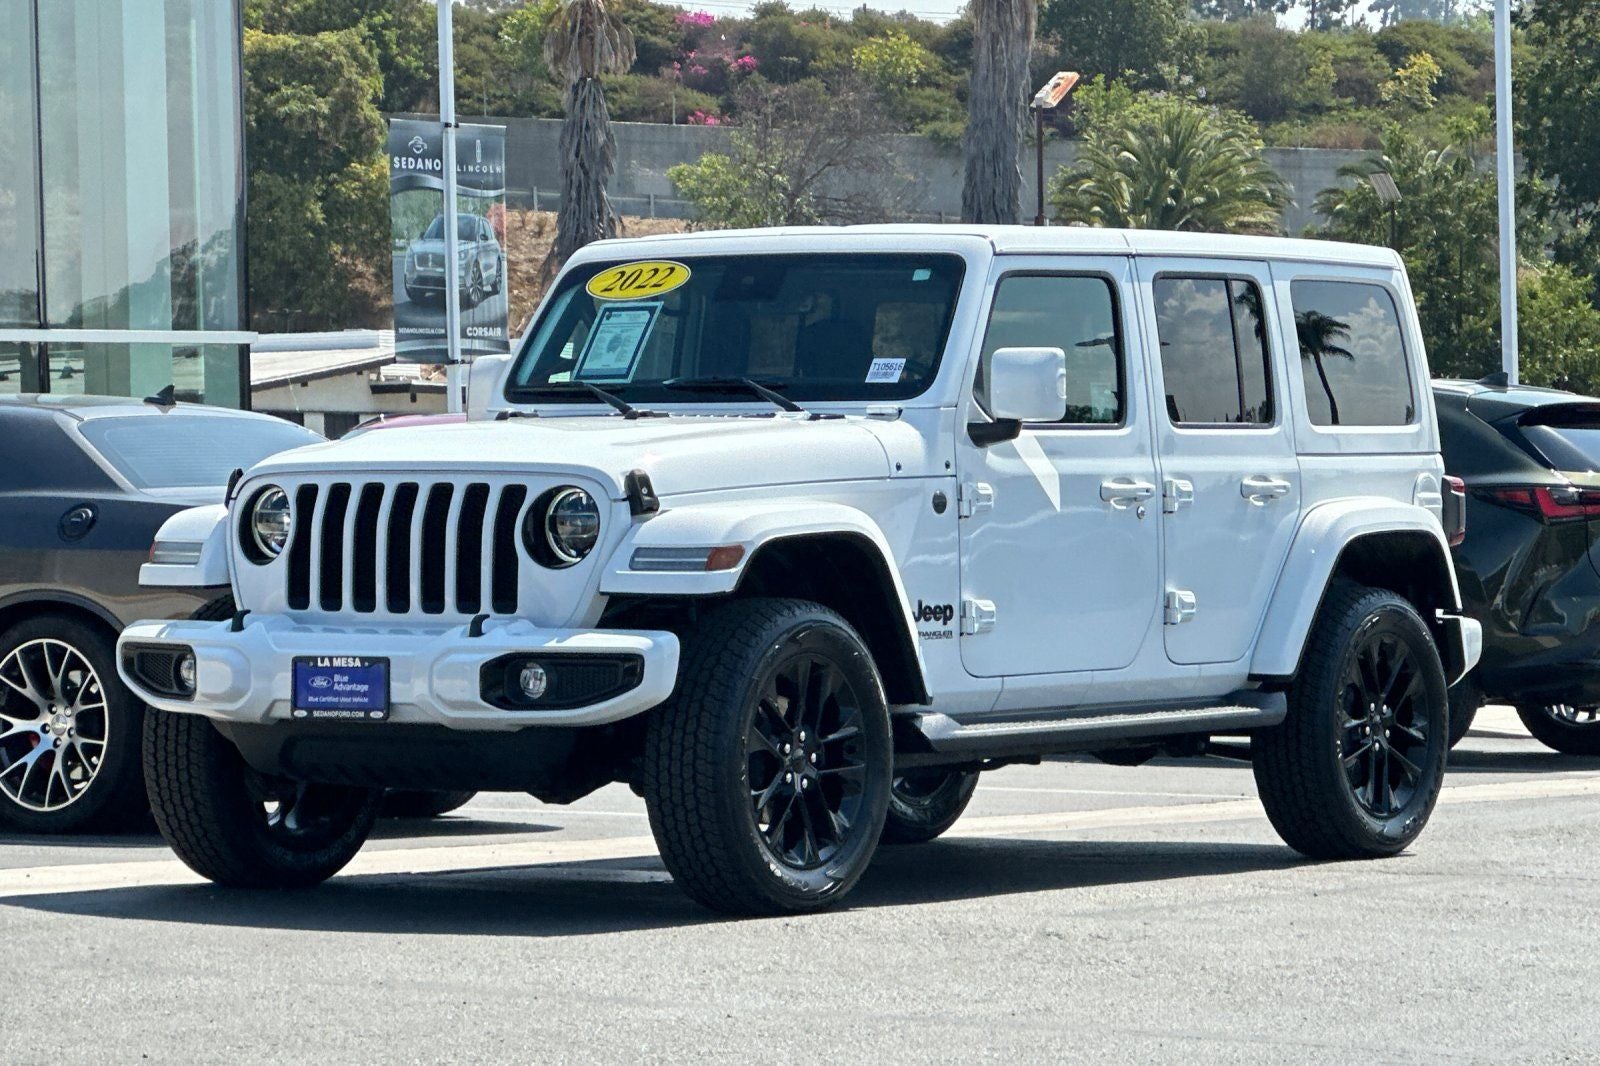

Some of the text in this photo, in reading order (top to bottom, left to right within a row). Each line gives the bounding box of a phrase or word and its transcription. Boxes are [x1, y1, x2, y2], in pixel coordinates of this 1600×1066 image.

[393, 156, 442, 171] SEDANO
[456, 164, 502, 174] LINCOLN
[600, 266, 676, 293] 2022
[466, 326, 502, 337] CORSAIR
[912, 599, 954, 626] Jeep
[917, 630, 953, 638] RANGLER
[317, 657, 362, 668] LA MESA
[333, 673, 349, 683] Blue
[333, 683, 369, 693] Advantage
[312, 710, 365, 718] SEDANOFORD.COM
